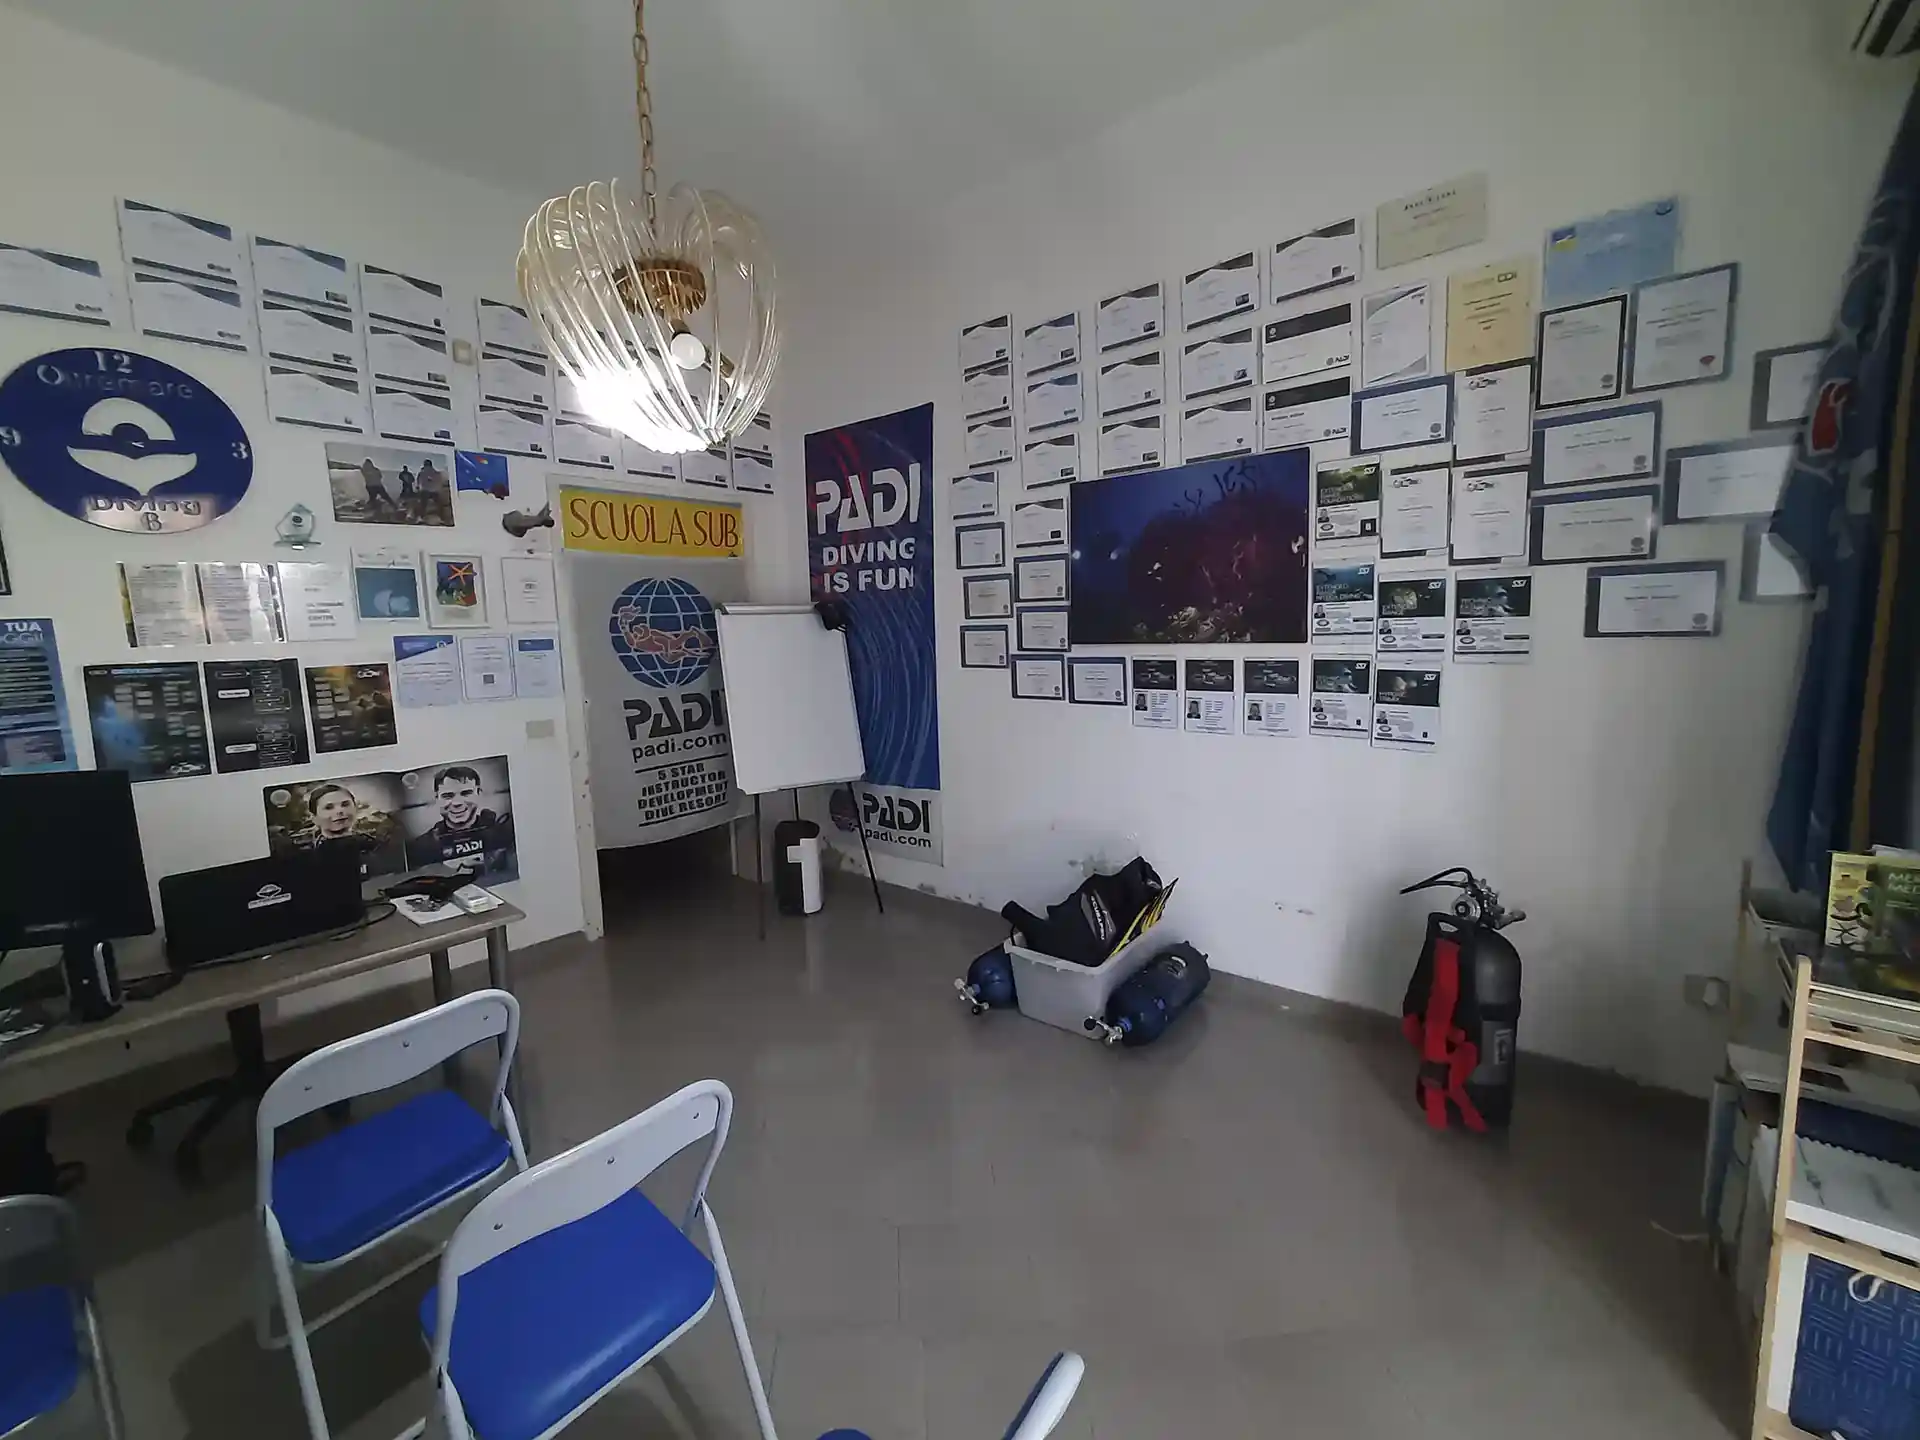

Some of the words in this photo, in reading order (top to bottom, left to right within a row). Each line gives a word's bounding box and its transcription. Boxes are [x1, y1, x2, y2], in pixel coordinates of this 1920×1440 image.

[94, 349, 134, 374] 12
[231, 441, 249, 460] 3
[815, 462, 921, 535] PADI
[569, 498, 688, 545] SCUOLA
[692, 510, 740, 548] SUB
[822, 537, 916, 567] DIVING
[823, 572, 850, 593] IS
[858, 566, 914, 592] FUN
[4, 621, 42, 632] TUA
[623, 689, 723, 740] PADI
[632, 733, 727, 763] padi.com
[642, 770, 727, 797] INSTRUCTOR
[658, 769, 667, 780] 5
[671, 763, 705, 778] STAR
[637, 781, 728, 810] DEVELOPMENT
[645, 804, 675, 821] DIVE
[679, 791, 727, 812] RESORT
[862, 792, 930, 833] PADI
[455, 839, 483, 854] PADI
[865, 828, 932, 848] padi.com
